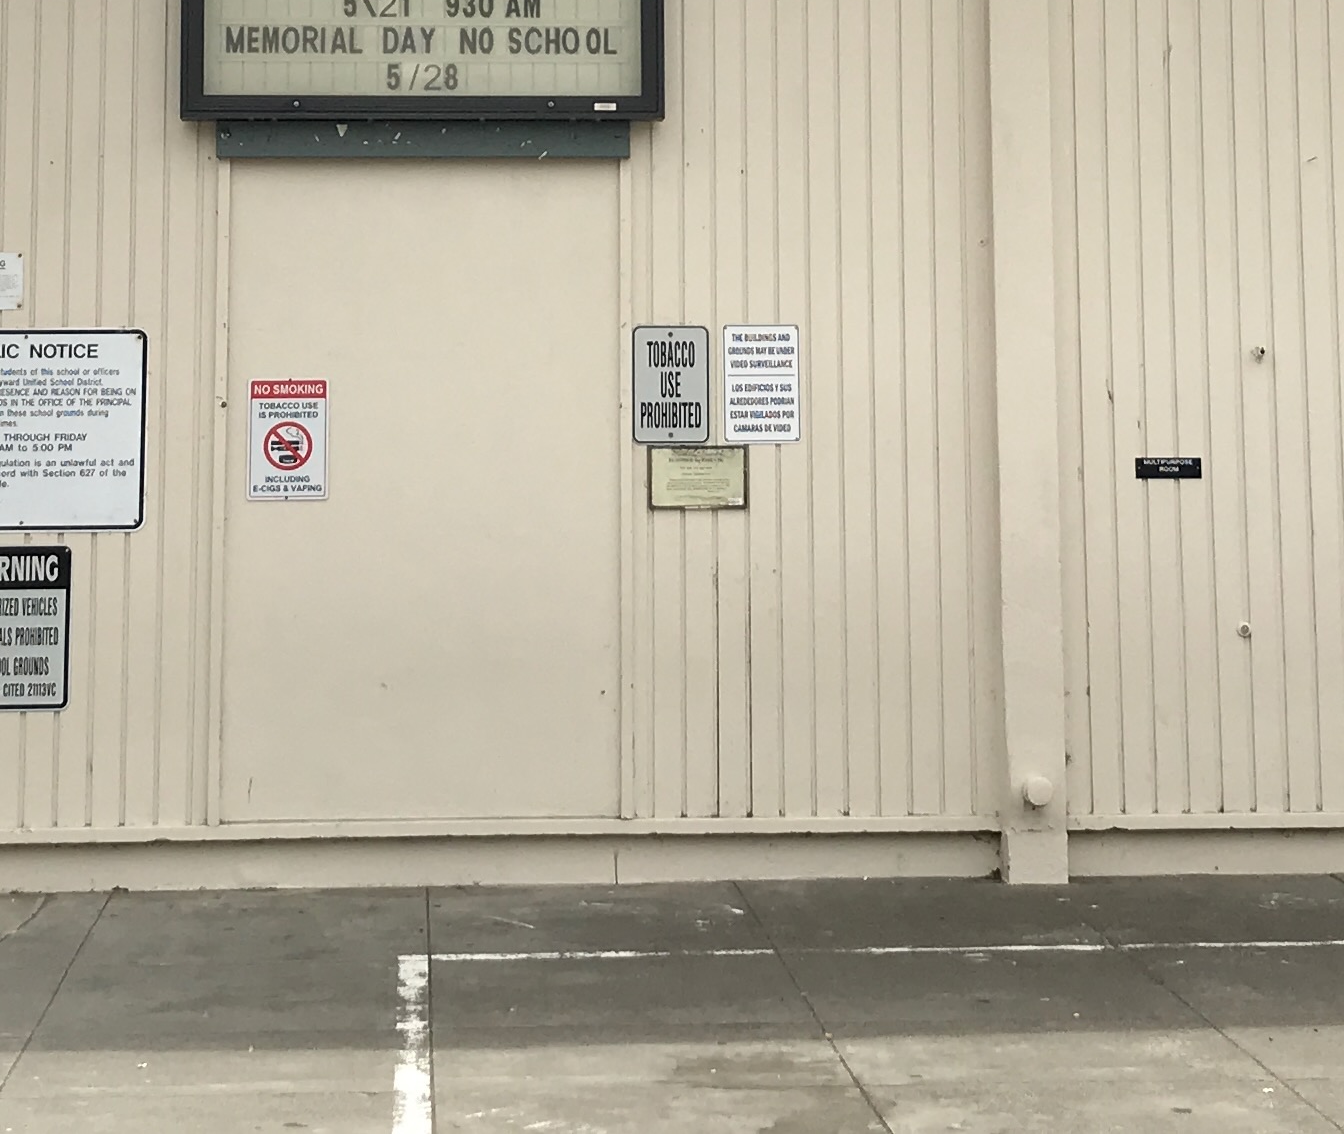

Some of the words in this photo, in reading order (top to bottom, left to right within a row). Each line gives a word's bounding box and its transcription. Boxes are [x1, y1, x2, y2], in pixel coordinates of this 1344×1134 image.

[225, 27, 363, 54] MEMORIAL
[382, 28, 435, 54] DAY
[459, 27, 494, 55] NO
[508, 28, 617, 55] SCHOOL
[386, 63, 459, 91] 5/28
[732, 334, 742, 342] THE
[30, 344, 99, 358] NOTICE
[647, 341, 695, 367] TOBACCO
[728, 347, 754, 355] GROUNDS
[756, 347, 767, 355] MAY
[768, 347, 775, 355] BE
[730, 360, 748, 368] VIDEO
[750, 360, 793, 368] SURVEILLANCE
[30, 368, 38, 376] of
[41, 368, 53, 376] this
[57, 368, 80, 376] school
[23, 378, 47, 386] Unified
[50, 378, 75, 386] School
[661, 372, 681, 398] USE
[33, 388, 48, 396] AND
[51, 388, 80, 396] REASON
[83, 388, 98, 396] FOR
[101, 388, 123, 396] BEING
[125, 388, 136, 396] ON
[254, 385, 270, 395] NO
[273, 384, 323, 394] SMOKING
[22, 398, 34, 406] THE
[38, 398, 63, 406] OFFICE
[66, 398, 76, 406] OF
[79, 398, 93, 406] THE
[96, 398, 132, 406] PRINCIPAL
[7, 409, 26, 417] these
[30, 409, 53, 417] school
[56, 409, 84, 418] grounds
[87, 409, 109, 418] during
[641, 402, 701, 428] PROHIBITED
[765, 424, 772, 432] DE
[773, 424, 791, 432] VIDEO
[4, 433, 50, 441] THROUGH
[54, 433, 87, 441] FRIDAY
[18, 444, 28, 452] to
[58, 443, 72, 451] PM
[34, 459, 42, 467] is
[60, 459, 96, 467] unlawful
[118, 458, 135, 466] and
[20, 469, 39, 477] with
[42, 469, 76, 477] Section
[79, 469, 95, 477] 627
[99, 469, 108, 477] of
[112, 469, 126, 477] the
[23, 597, 58, 616] VEHICLES
[15, 627, 58, 646] PROHIBITED
[14, 657, 49, 676] GROUNDS
[3, 683, 24, 697] CITED
